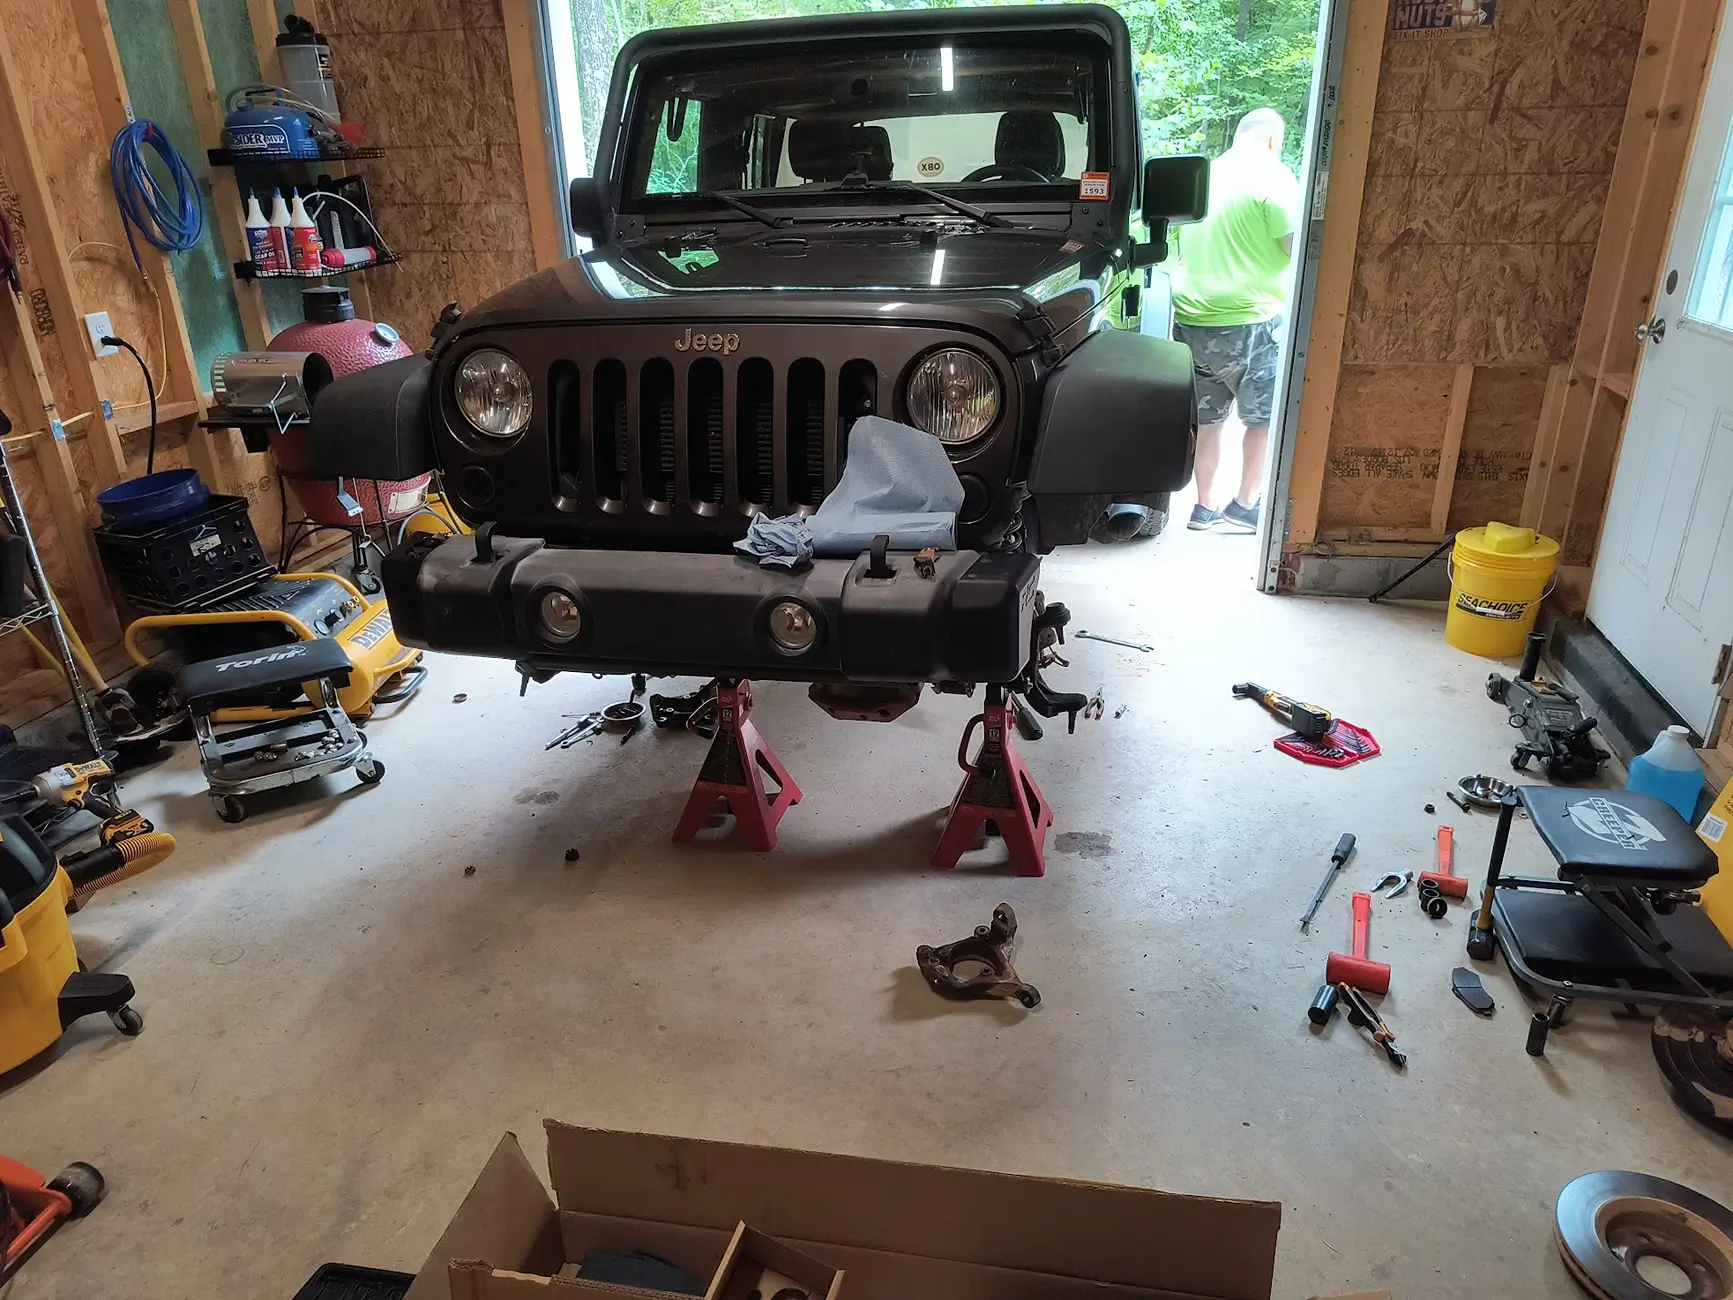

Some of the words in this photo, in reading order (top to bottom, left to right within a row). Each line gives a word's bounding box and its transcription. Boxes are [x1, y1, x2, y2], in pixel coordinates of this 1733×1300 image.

[1394, 4, 1446, 29] NUTS
[1394, 31, 1421, 40] FIX-IT
[1424, 29, 1449, 39] SHOP
[675, 328, 740, 356] Jeep
[215, 652, 297, 672] Torin
[1592, 798, 1638, 849] CREEPER
